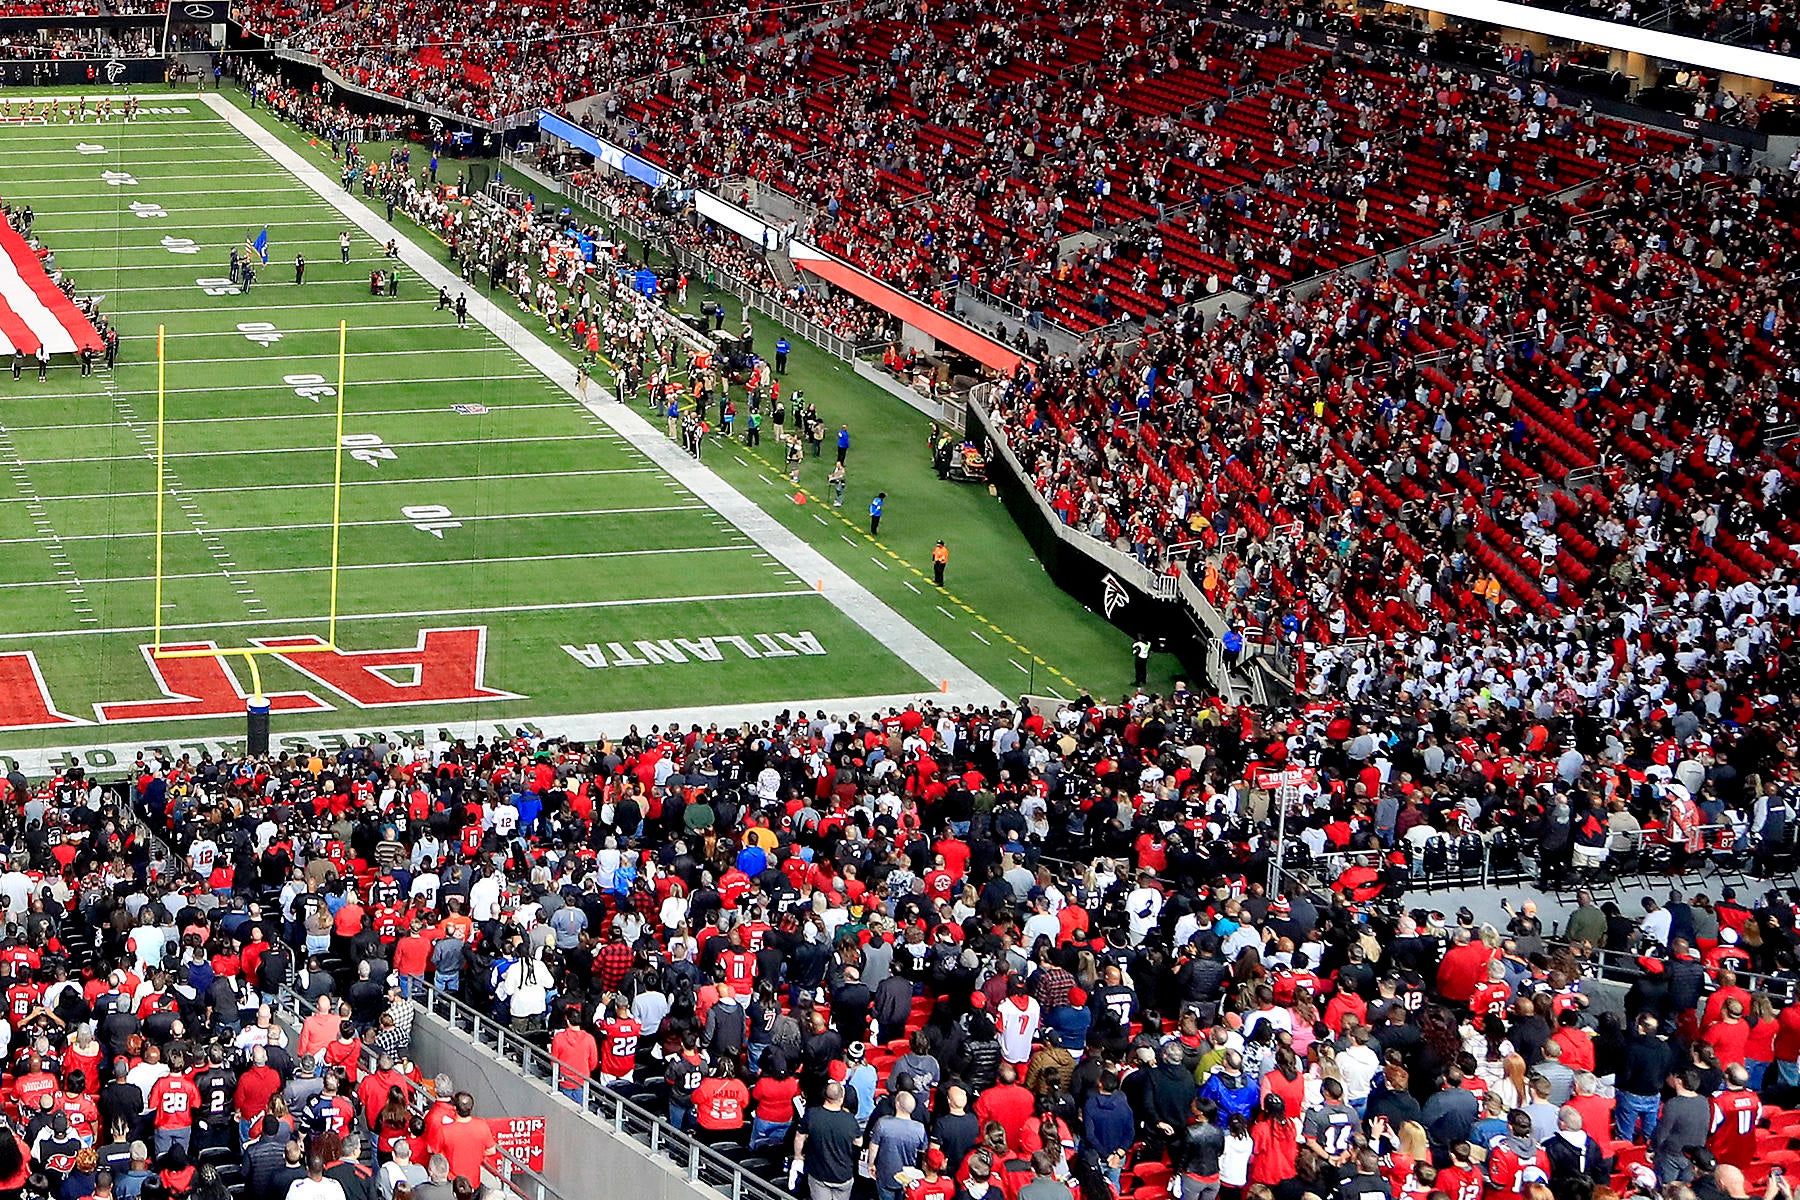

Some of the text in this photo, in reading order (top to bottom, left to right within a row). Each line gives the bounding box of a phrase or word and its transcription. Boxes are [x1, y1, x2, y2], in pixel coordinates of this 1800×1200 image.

[283, 374, 338, 397] 30
[340, 434, 399, 461] 20
[400, 505, 463, 530] 10
[560, 631, 827, 669] ATLANTA
[979, 730, 990, 742] 14
[729, 769, 738, 780] 11
[500, 817, 511, 827] 12
[469, 835, 478, 847] 11
[199, 849, 213, 864] 12
[330, 848, 341, 858] 12
[426, 888, 432, 900] 8
[1085, 898, 1099, 910] 13
[733, 962, 744, 979] 11
[912, 957, 924, 970] 11
[14, 1000, 28, 1014] 18
[1403, 991, 1423, 1012] 12
[763, 1012, 777, 1031] 7
[1018, 1015, 1029, 1035] 7
[612, 1035, 638, 1056] 22
[684, 1072, 702, 1089] 12
[210, 1090, 225, 1112] 2
[712, 1090, 739, 1098] BRADY
[162, 1092, 188, 1113] 28
[509, 1119, 532, 1133] 101
[1738, 1110, 1751, 1134] 11
[508, 1147, 531, 1160] 101
